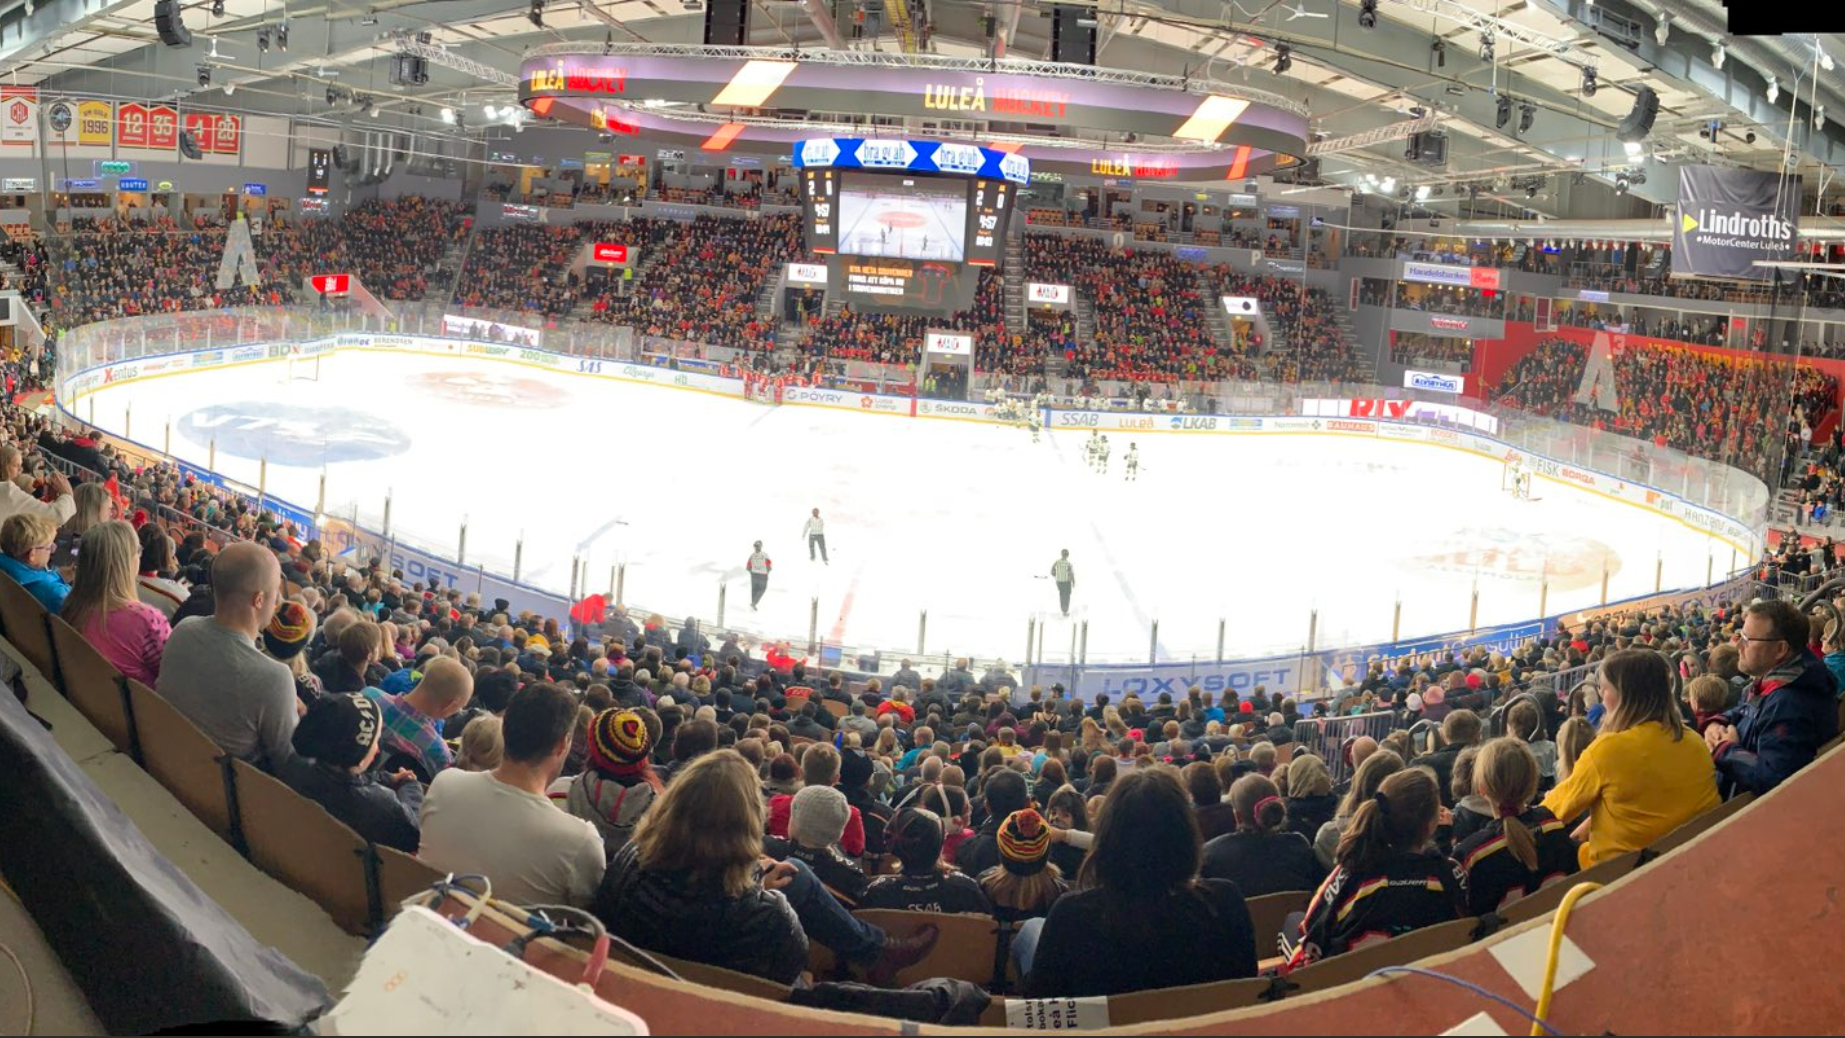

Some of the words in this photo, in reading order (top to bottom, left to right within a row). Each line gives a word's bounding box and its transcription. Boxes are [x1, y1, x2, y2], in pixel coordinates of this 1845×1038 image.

[924, 77, 986, 112] LULEÅ
[993, 88, 1070, 119] HOCKEY
[82, 120, 109, 134] 1996
[123, 111, 143, 134] 12
[153, 114, 173, 136] 35
[1091, 153, 1131, 177] LULEÅ
[976, 190, 984, 207] 2
[1699, 208, 1792, 240] Lindroths
[1702, 235, 1759, 250] MotorCenter
[1760, 240, 1785, 251] Luleå
[1409, 266, 1470, 281] Handelsbanken
[576, 359, 603, 374] SAS
[1060, 412, 1100, 427] SSAB
[1182, 416, 1218, 431] LKAB
[1326, 420, 1376, 433] BAUHAUS
[1102, 668, 1291, 696] LOXYSOFT
